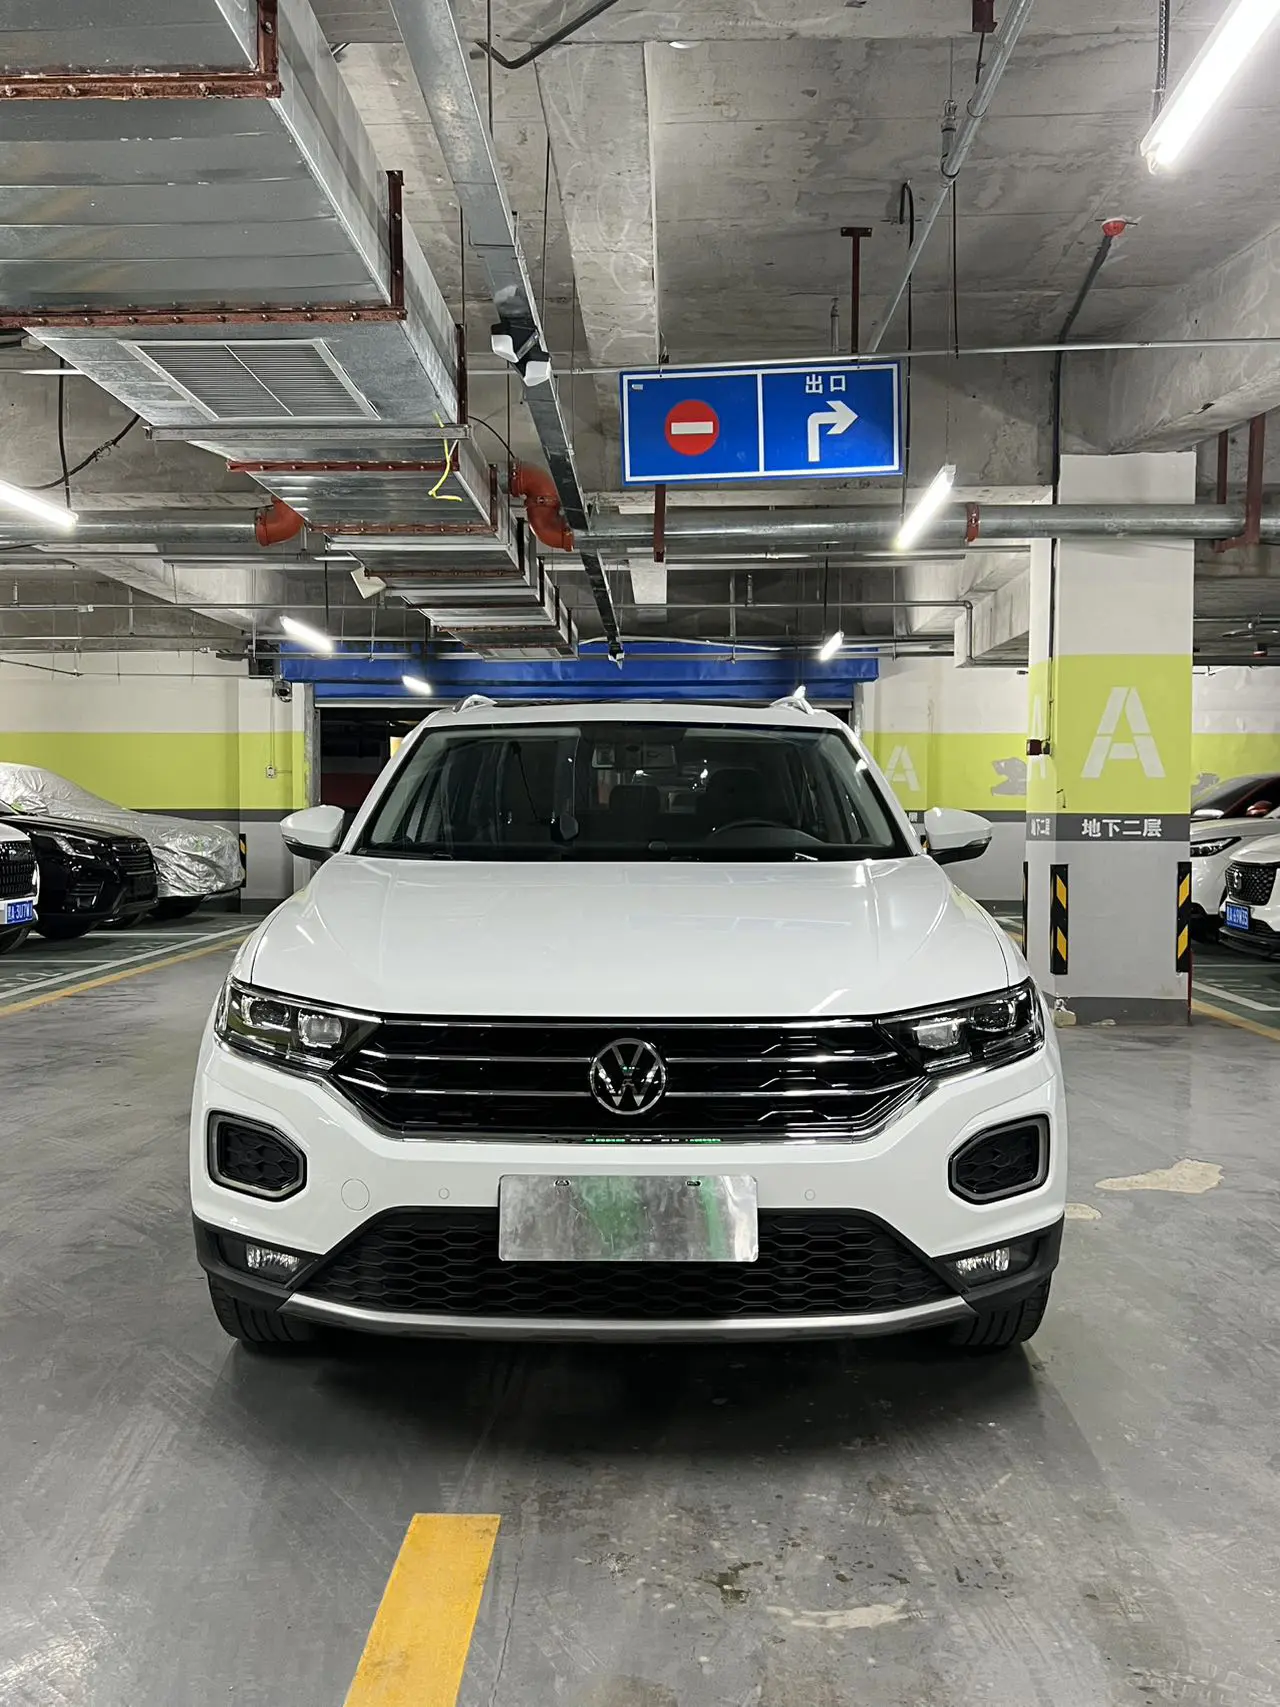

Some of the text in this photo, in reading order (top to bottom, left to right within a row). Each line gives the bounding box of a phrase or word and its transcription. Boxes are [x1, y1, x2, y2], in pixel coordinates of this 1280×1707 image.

[805, 373, 846, 394] 出口
[1080, 686, 1167, 778] A
[884, 745, 921, 792] A
[1081, 818, 1163, 838] 地下二层
